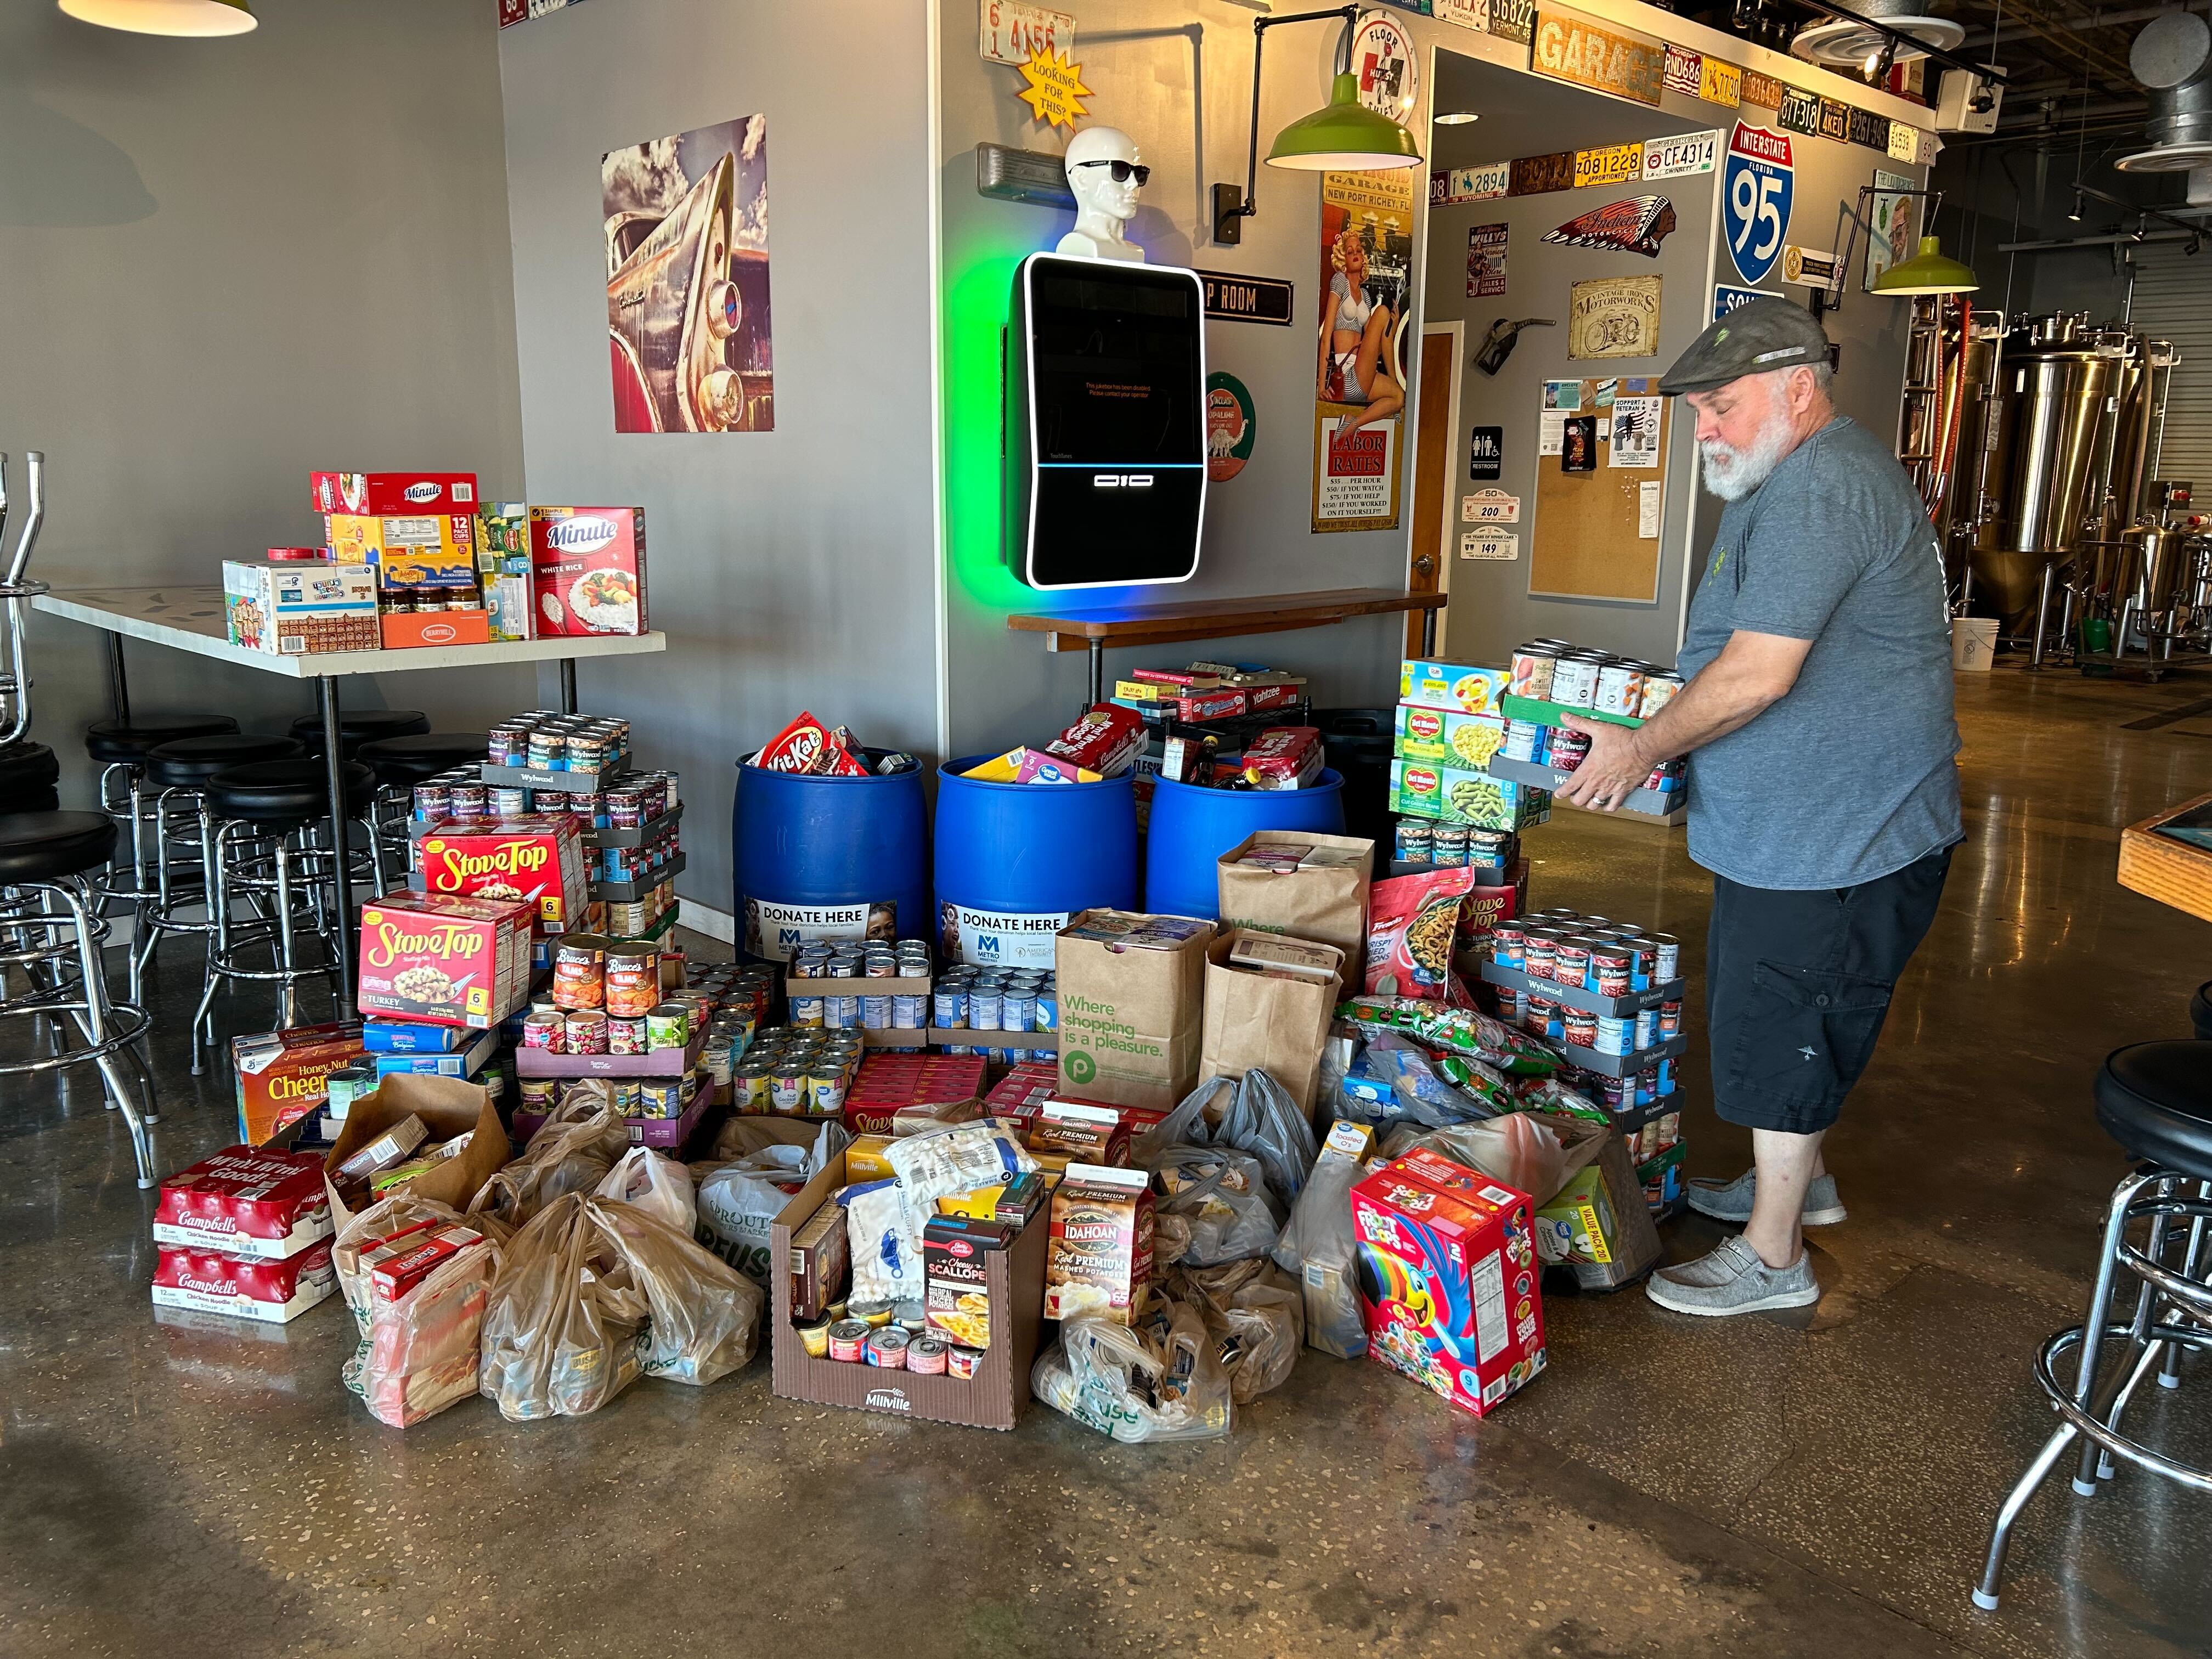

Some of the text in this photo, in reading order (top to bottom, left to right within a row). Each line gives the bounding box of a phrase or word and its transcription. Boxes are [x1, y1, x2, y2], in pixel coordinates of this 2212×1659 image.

[1451, 9, 1473, 22] YUKON
[1492, 18, 1531, 39] VERMONT 45
[1369, 28, 1398, 49] FLOOR
[1538, 20, 1664, 98] GARAGE
[1033, 61, 1075, 89] LOOKING
[1664, 53, 1700, 82] RND686
[1044, 83, 1063, 100] FOR
[1040, 97, 1066, 117] THIS?
[1661, 134, 1702, 148] GEORGIA
[1740, 129, 1787, 160] INTERSTATE
[1595, 147, 1621, 157] OREGON
[1749, 161, 1774, 176] FLORIDA
[1328, 174, 1410, 196] GARAGE
[1475, 171, 1506, 194] 2894
[1588, 172, 1625, 183] APPORTIONED
[1328, 188, 1409, 211] NEW PORT RICHEY, FL
[1732, 168, 1783, 261] 95
[1471, 231, 1507, 245] WILLYS
[1581, 228, 1641, 238] MOTORCYCLE
[1481, 286, 1505, 294] SERVICE
[1482, 280, 1499, 288] SALES
[1575, 295, 1655, 320] MOTORWORKS
[1208, 411, 1235, 419] OPALINE
[1333, 435, 1383, 452] LABOR
[1333, 456, 1381, 472] RATES
[404, 482, 442, 501] Minute
[1481, 506, 1499, 517] 200
[452, 516, 469, 529] 12
[548, 520, 618, 549] Minute
[1481, 544, 1497, 554] 149
[540, 563, 583, 574] WHITE RICE
[425, 628, 453, 637] BERRYHILL
[1253, 685, 1280, 706] Yahtzee
[1099, 733, 1128, 766] Campbell's
[1553, 738, 1587, 751] Wylwood
[572, 749, 601, 759] Wylwood
[521, 774, 554, 784] Wylwood
[1504, 782, 1512, 792] 8
[453, 798, 484, 807] Wylwood
[535, 803, 566, 811] Wylwood
[610, 804, 640, 814] Wylwood
[1435, 840, 1465, 849] Wylwood
[545, 901, 554, 911] 6
[1458, 894, 1505, 923] Stove
[764, 906, 862, 923] DONATE HERE
[963, 912, 1061, 931] DONATE HERE
[1231, 917, 1284, 933] Where
[556, 948, 590, 965] Bruce's
[977, 950, 1000, 960] METRO
[1556, 955, 1588, 967] Wylwood
[561, 965, 583, 975] YAMS
[607, 958, 643, 973] Bruce's
[614, 974, 637, 984] YAMS
[1527, 979, 1563, 997] Wylwood
[368, 994, 400, 1007] TURKEY
[472, 993, 480, 1004] 6
[1639, 989, 1664, 1005] Wylwood
[1063, 994, 1115, 1016] Where
[1064, 1013, 1135, 1040] shopping
[1065, 1029, 1164, 1059] is a pleasure.
[1644, 1048, 1668, 1063] Wylwood
[298, 1058, 349, 1076] Honey Nut
[268, 1073, 329, 1101] Cheer
[304, 1092, 320, 1102] Real
[1062, 1121, 1092, 1129] IDAHOAN
[1042, 1128, 1098, 1142] Real PREMIUM
[1335, 1130, 1363, 1144] Toasted
[1340, 1139, 1352, 1148] O's
[205, 1155, 309, 1176] M'm! M'm!
[341, 1153, 371, 1175] SCALLOPED
[850, 1160, 879, 1172] Millville
[208, 1167, 272, 1184] Good!
[1086, 1190, 1126, 1200] PREMIUM
[177, 1209, 236, 1233] Campbell's
[1357, 1210, 1397, 1234] FROOT
[187, 1231, 230, 1243] Chicken Noodle
[1064, 1224, 1118, 1240] IDAHOAN
[1363, 1226, 1402, 1250] LOOPS
[1583, 1207, 1607, 1259] VALUE PACK 20
[399, 1247, 437, 1269] Instant
[948, 1257, 974, 1270] Cheesy
[1054, 1250, 1125, 1271] Real PREMIUM
[928, 1263, 986, 1281] SCALLOPE
[1053, 1263, 1125, 1278] MASHED POTATOES
[177, 1272, 237, 1295] Campbell's
[187, 1293, 208, 1301] Chicken
[928, 1296, 954, 1306] SLICED
[937, 1288, 954, 1300] REAL
[1519, 1328, 1537, 1344] NOSE
[1465, 1374, 1473, 1386] 9
[865, 1392, 911, 1412] Millville
